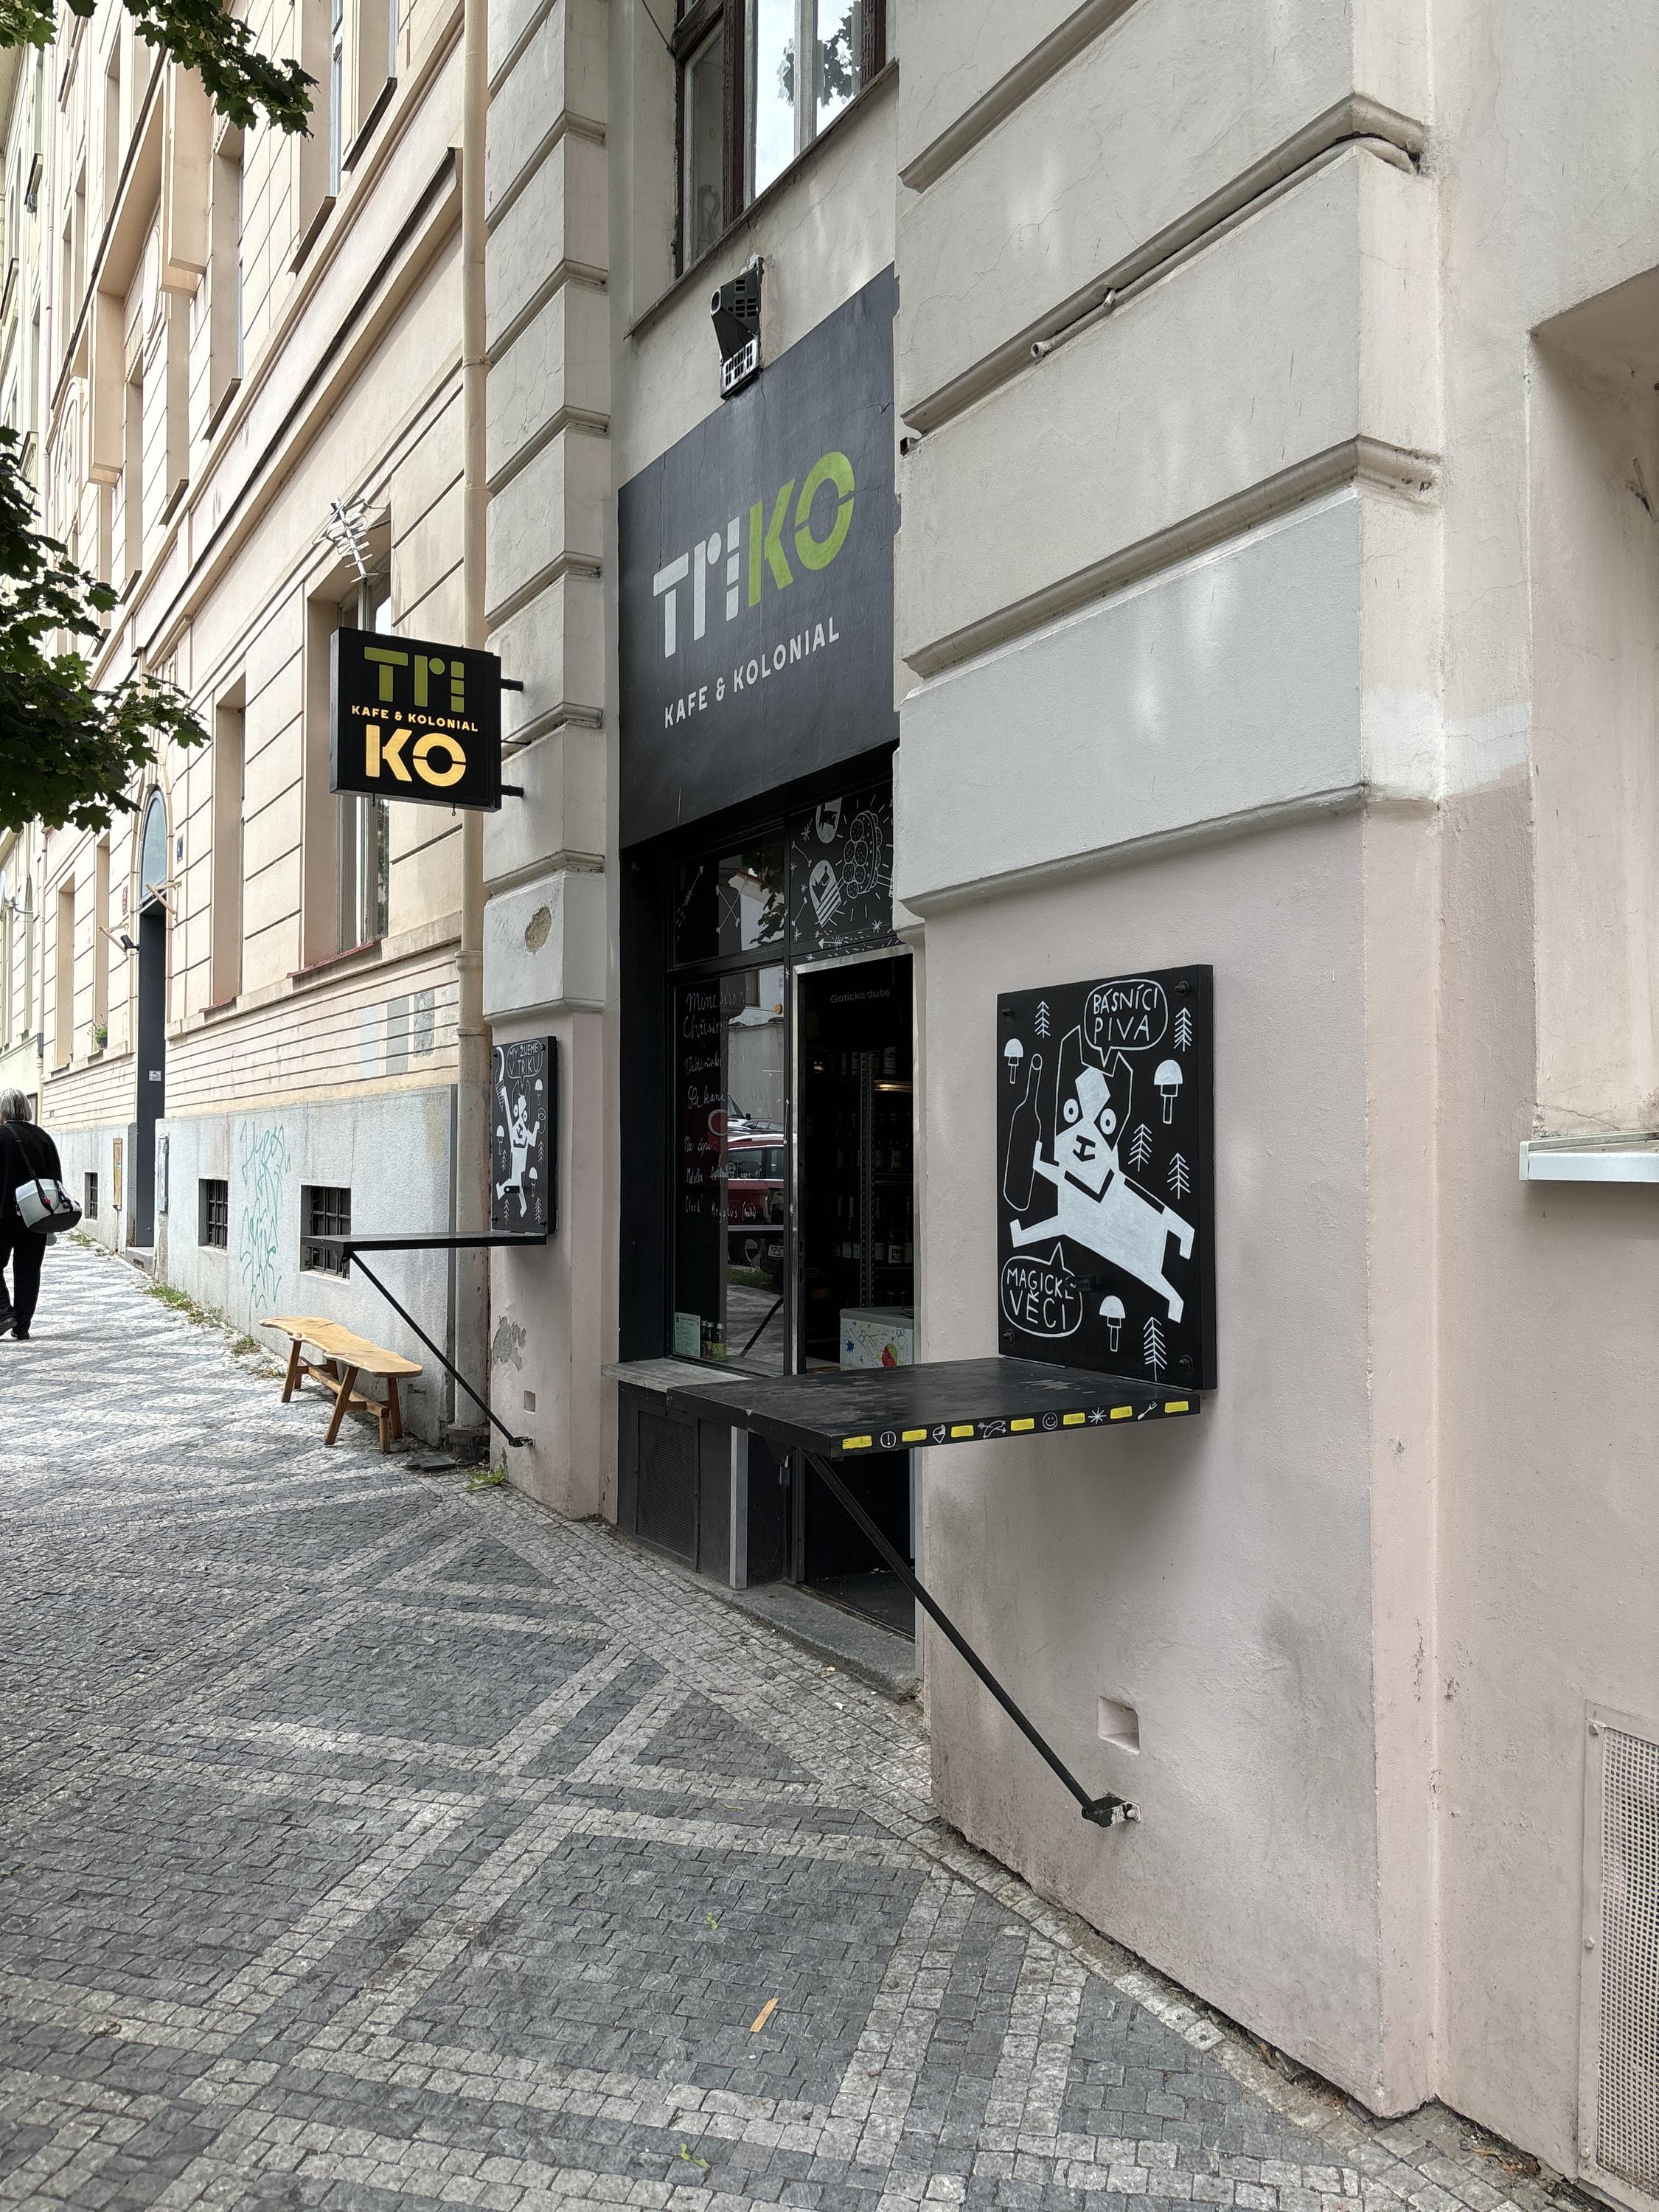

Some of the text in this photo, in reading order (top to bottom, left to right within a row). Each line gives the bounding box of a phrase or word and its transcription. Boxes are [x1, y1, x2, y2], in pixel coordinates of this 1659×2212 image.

[665, 617, 840, 729] KAFE & KOLONIAL
[352, 705, 479, 732] KAFE & KOLONIAL
[366, 724, 466, 787] KO
[867, 988, 891, 998] duše
[1093, 984, 1158, 1015] BÁSNÍCI
[1094, 1015, 1150, 1045] PIVA
[509, 1048, 519, 1060] MY
[509, 1054, 540, 1076] V TRIKU
